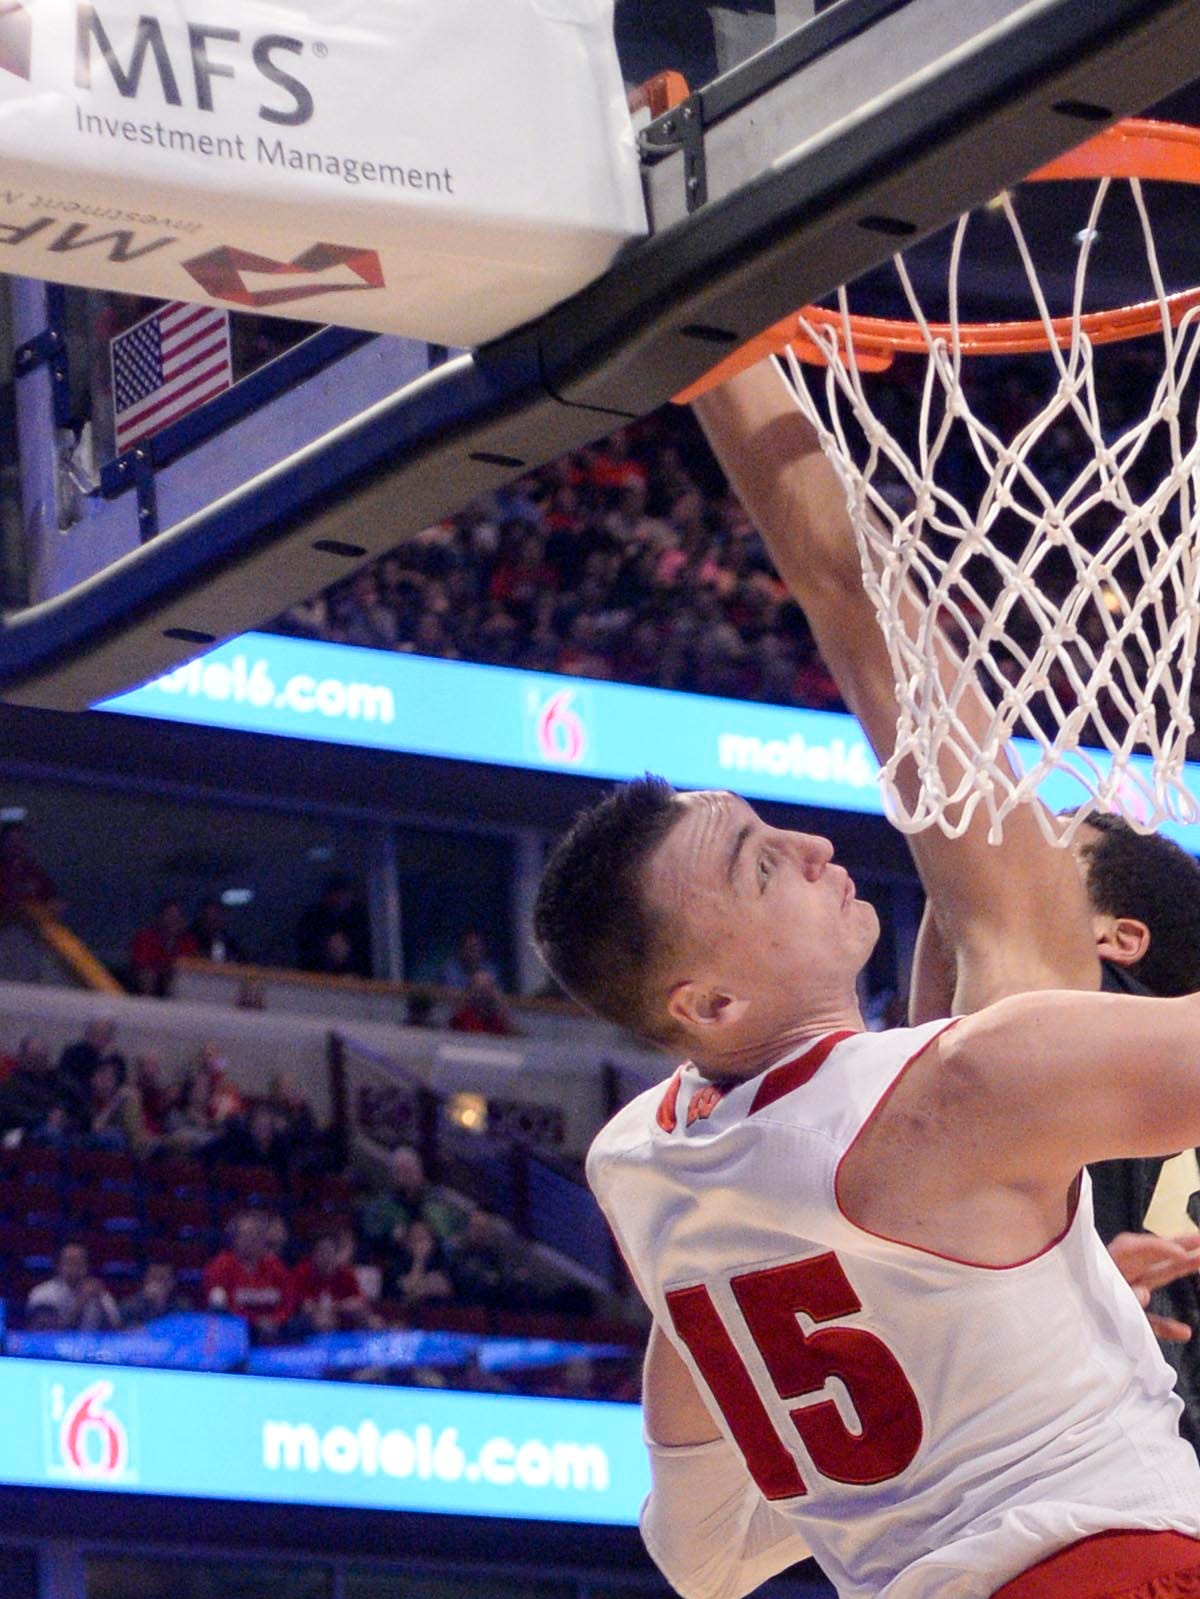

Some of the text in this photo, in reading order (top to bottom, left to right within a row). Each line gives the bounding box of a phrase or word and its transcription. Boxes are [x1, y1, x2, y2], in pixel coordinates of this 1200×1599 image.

[76, 105, 455, 194] Investment Management
[718, 733, 882, 788] motel6.
[665, 1251, 923, 1501] 15
[262, 1418, 609, 1492] motel6.com
